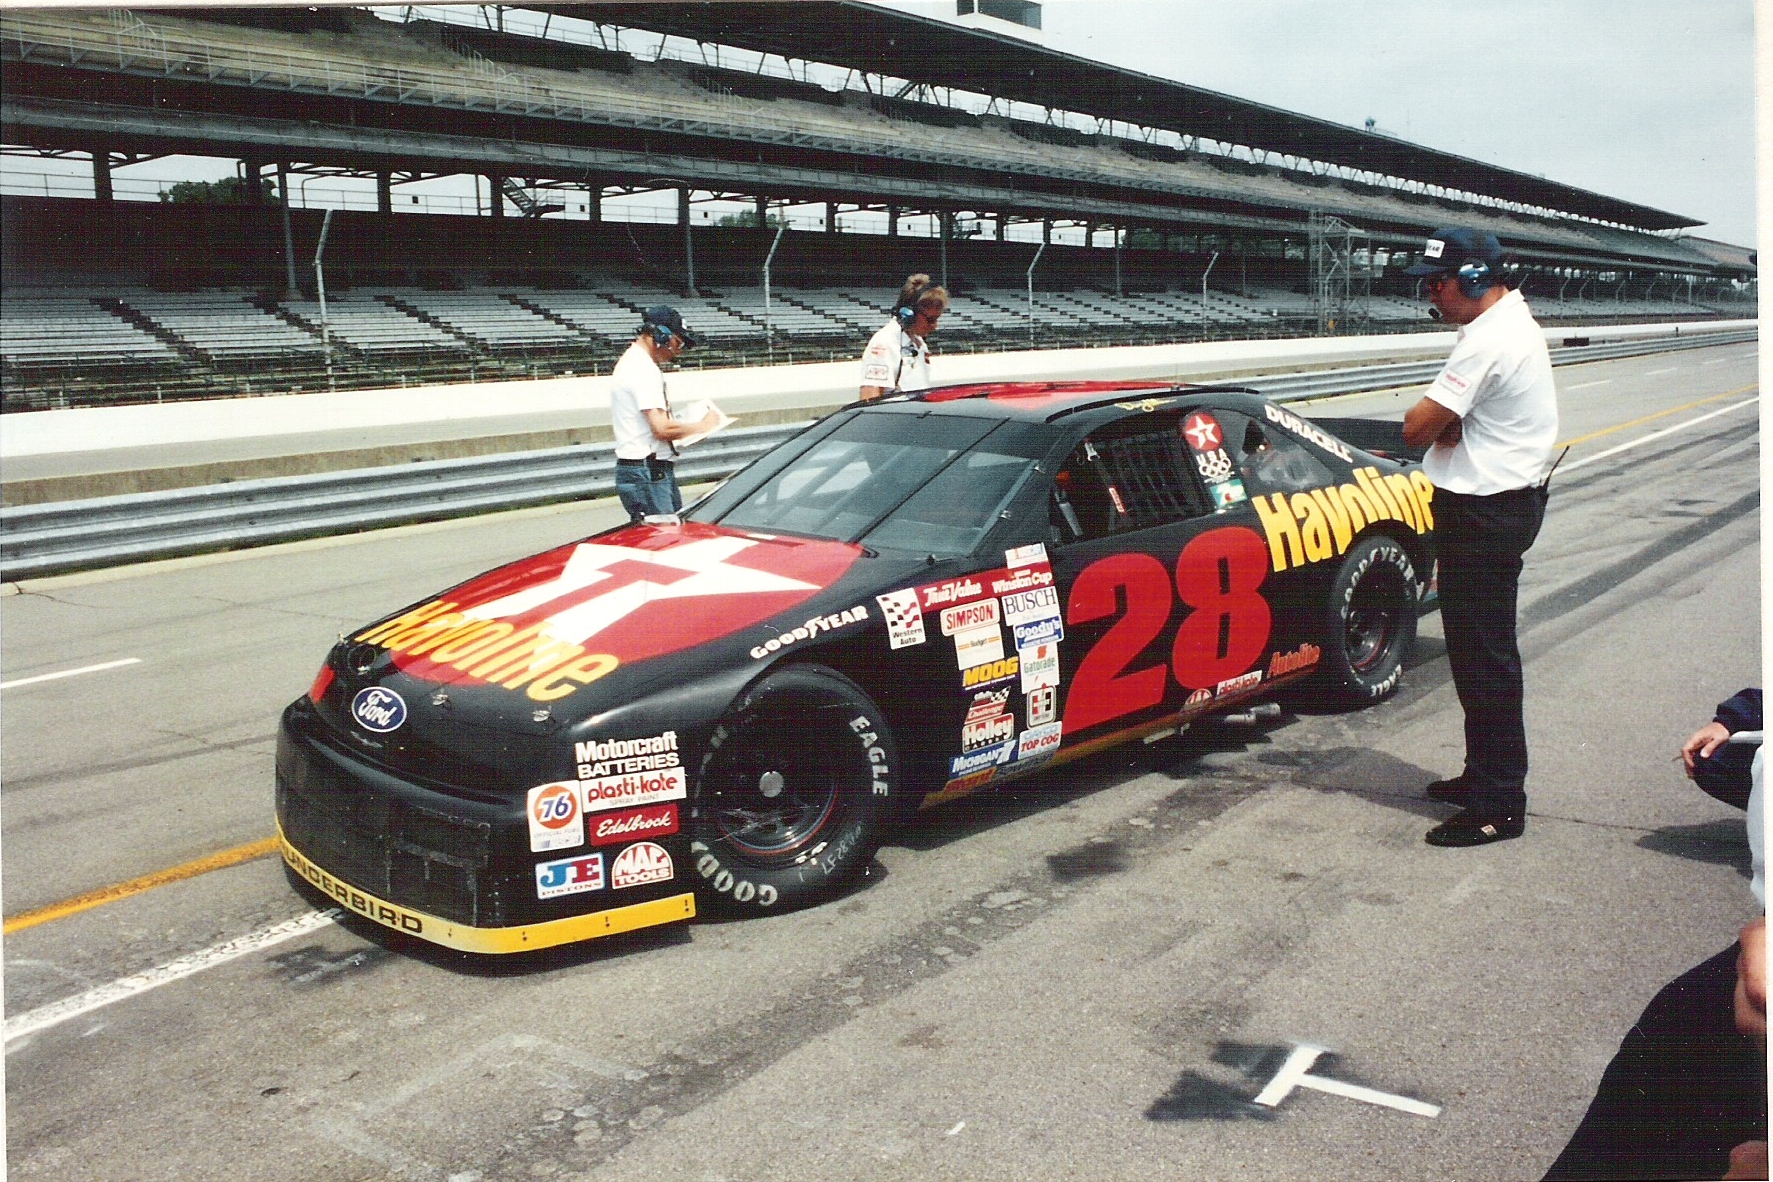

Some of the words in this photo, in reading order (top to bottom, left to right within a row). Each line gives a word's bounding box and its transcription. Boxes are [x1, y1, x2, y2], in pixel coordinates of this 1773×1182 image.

[1264, 403, 1353, 464] DURACELL
[1252, 465, 1435, 573] Havoline
[991, 571, 1032, 594] Winston
[1031, 571, 1053, 587] Cup
[1003, 588, 1058, 615] BUSCH
[946, 603, 994, 631] SIMPSON
[1015, 620, 1061, 640] Goody's
[1062, 526, 1271, 735] 28
[749, 604, 869, 660] GOODYEAR
[892, 627, 923, 639] Western
[899, 636, 917, 646] Auto
[963, 656, 1019, 687] MOOG
[1023, 656, 1056, 674] Gatorade
[358, 690, 398, 727] Ford
[963, 716, 1012, 746] Holley
[574, 730, 679, 764] Motorcraft
[848, 715, 889, 797] EAGLE
[1020, 741, 1041, 762] TOP
[577, 752, 680, 780] BATTERIES
[540, 793, 571, 821] 76
[595, 811, 672, 838] Edelbrock
[540, 856, 601, 888] JE
[616, 844, 669, 877] MAC
[541, 882, 602, 897] PISTONS
[614, 868, 672, 887] TOOLS
